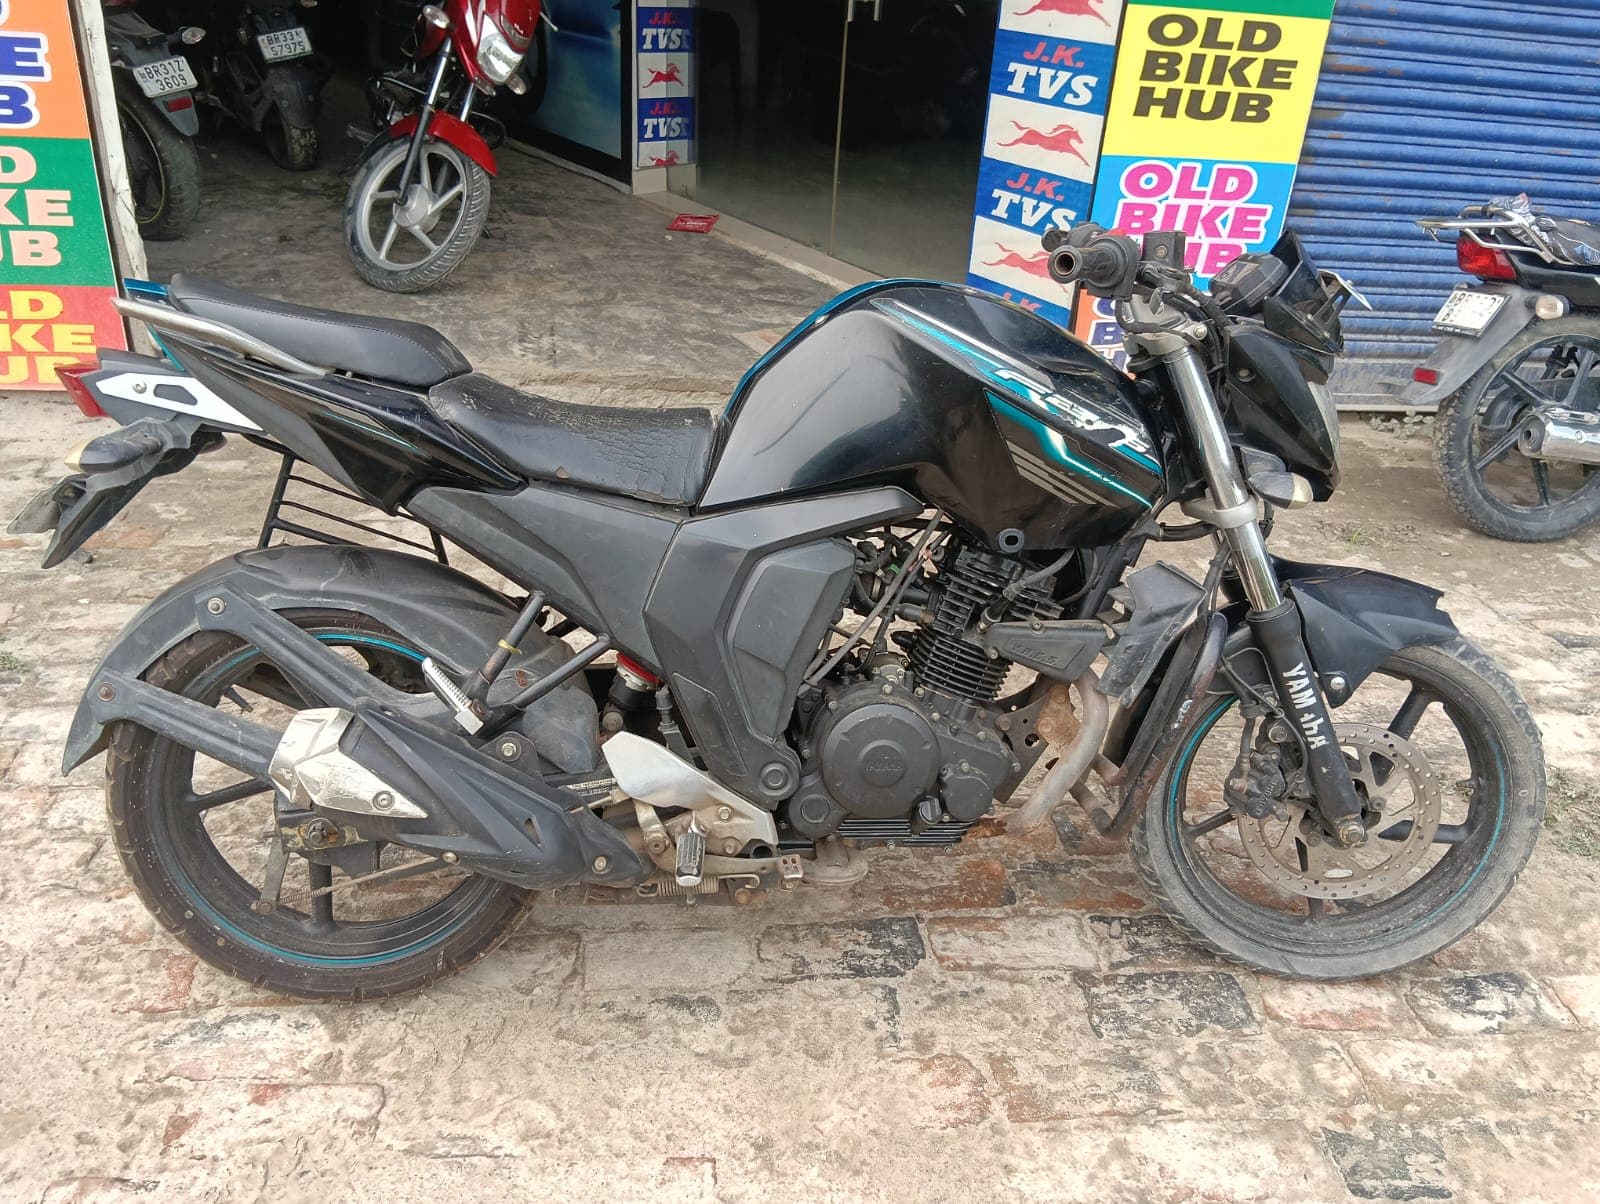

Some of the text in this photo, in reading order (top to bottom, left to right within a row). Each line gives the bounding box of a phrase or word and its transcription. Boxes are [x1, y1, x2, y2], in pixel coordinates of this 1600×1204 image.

[642, 28, 682, 49] TVS
[1147, 13, 1282, 53] OLD
[1023, 41, 1085, 69] J.K.
[1139, 50, 1299, 91] BIKE
[155, 73, 188, 91] 3609
[1007, 61, 1098, 106] TVS
[1132, 86, 1274, 124] HUB
[643, 117, 682, 139] TVS
[1006, 172, 1065, 201] J.K.
[1123, 163, 1254, 201] OLD
[991, 188, 1077, 232] TVS
[1119, 202, 1269, 240] BIKE
